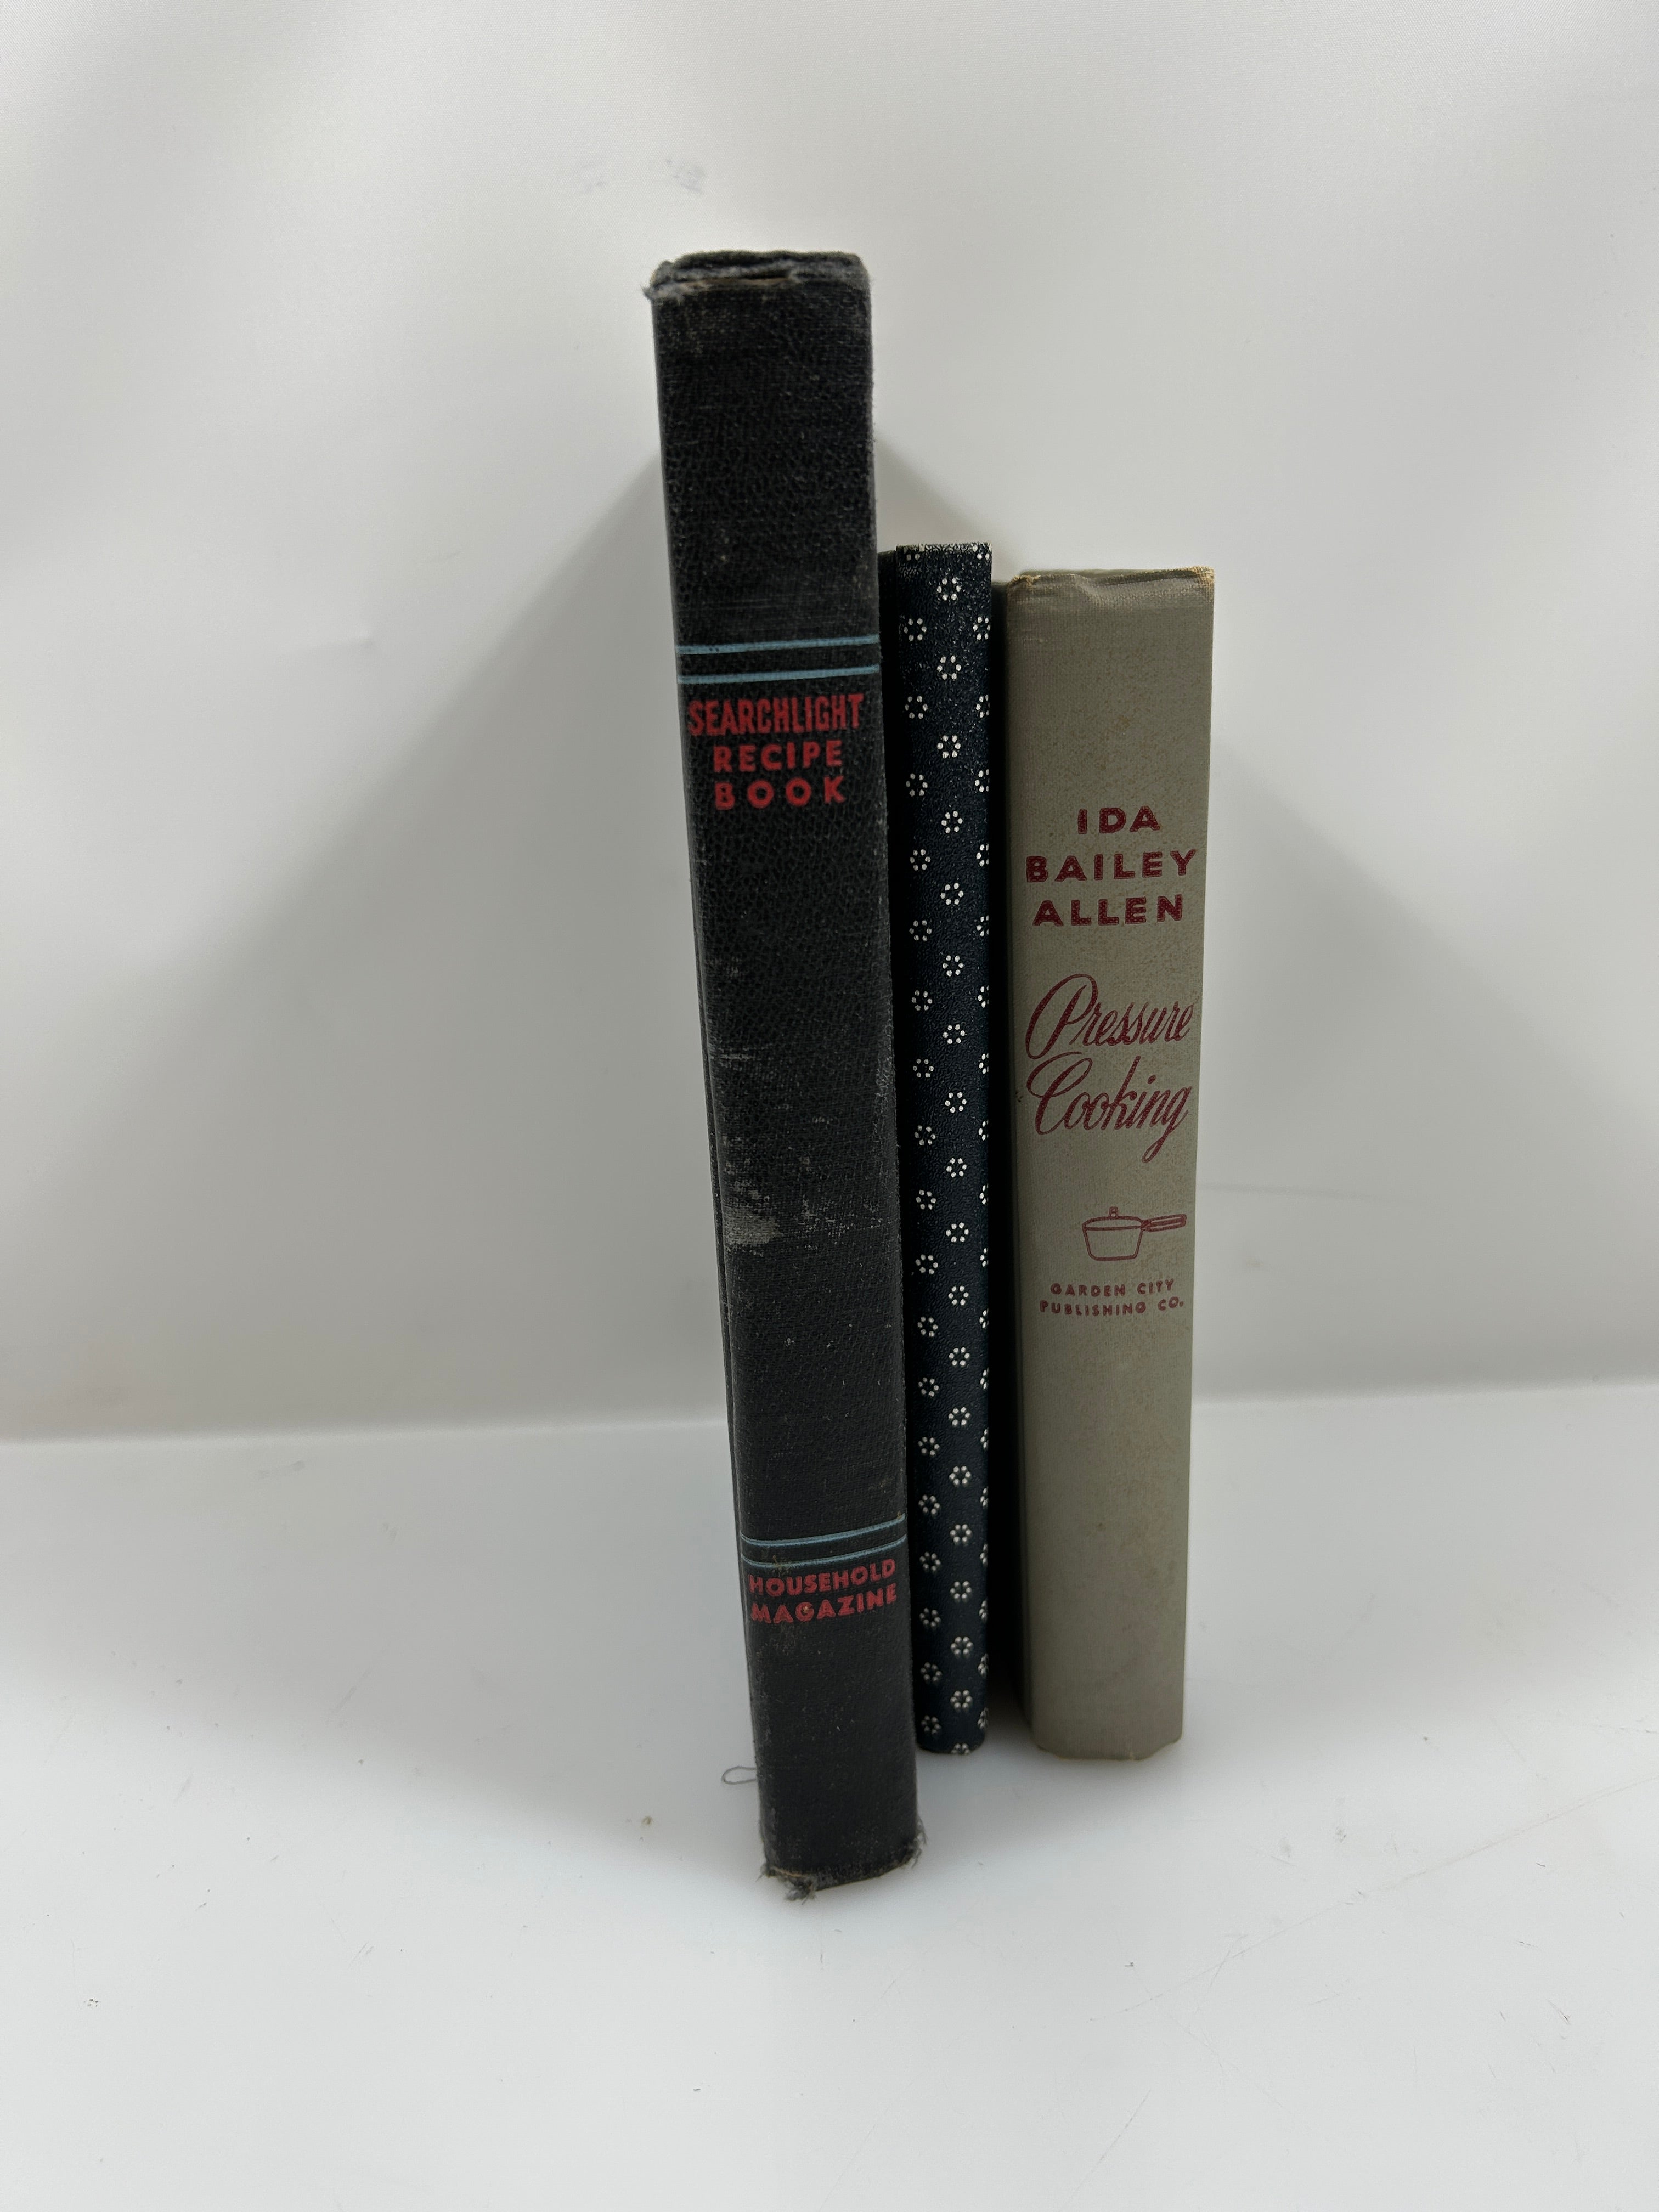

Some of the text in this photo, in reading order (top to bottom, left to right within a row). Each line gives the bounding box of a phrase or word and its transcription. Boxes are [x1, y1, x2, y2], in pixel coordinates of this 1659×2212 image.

[687, 693, 864, 736] SEARCHLIGHT
[714, 740, 843, 772] RECIPE
[715, 775, 845, 810] BOOK
[1077, 805, 1160, 834] IDA
[1026, 849, 1196, 882] BAILEY
[1032, 894, 1183, 926] ALLEN
[1025, 973, 1194, 1059] Pressure
[1026, 1051, 1192, 1163] Cooking
[1050, 1278, 1174, 1297] GARDEN CITY
[1040, 1296, 1184, 1317] PUBLISHING CO.
[748, 1558, 896, 1596] HOUSEHOLD
[751, 1583, 897, 1624] MAGAZINE
